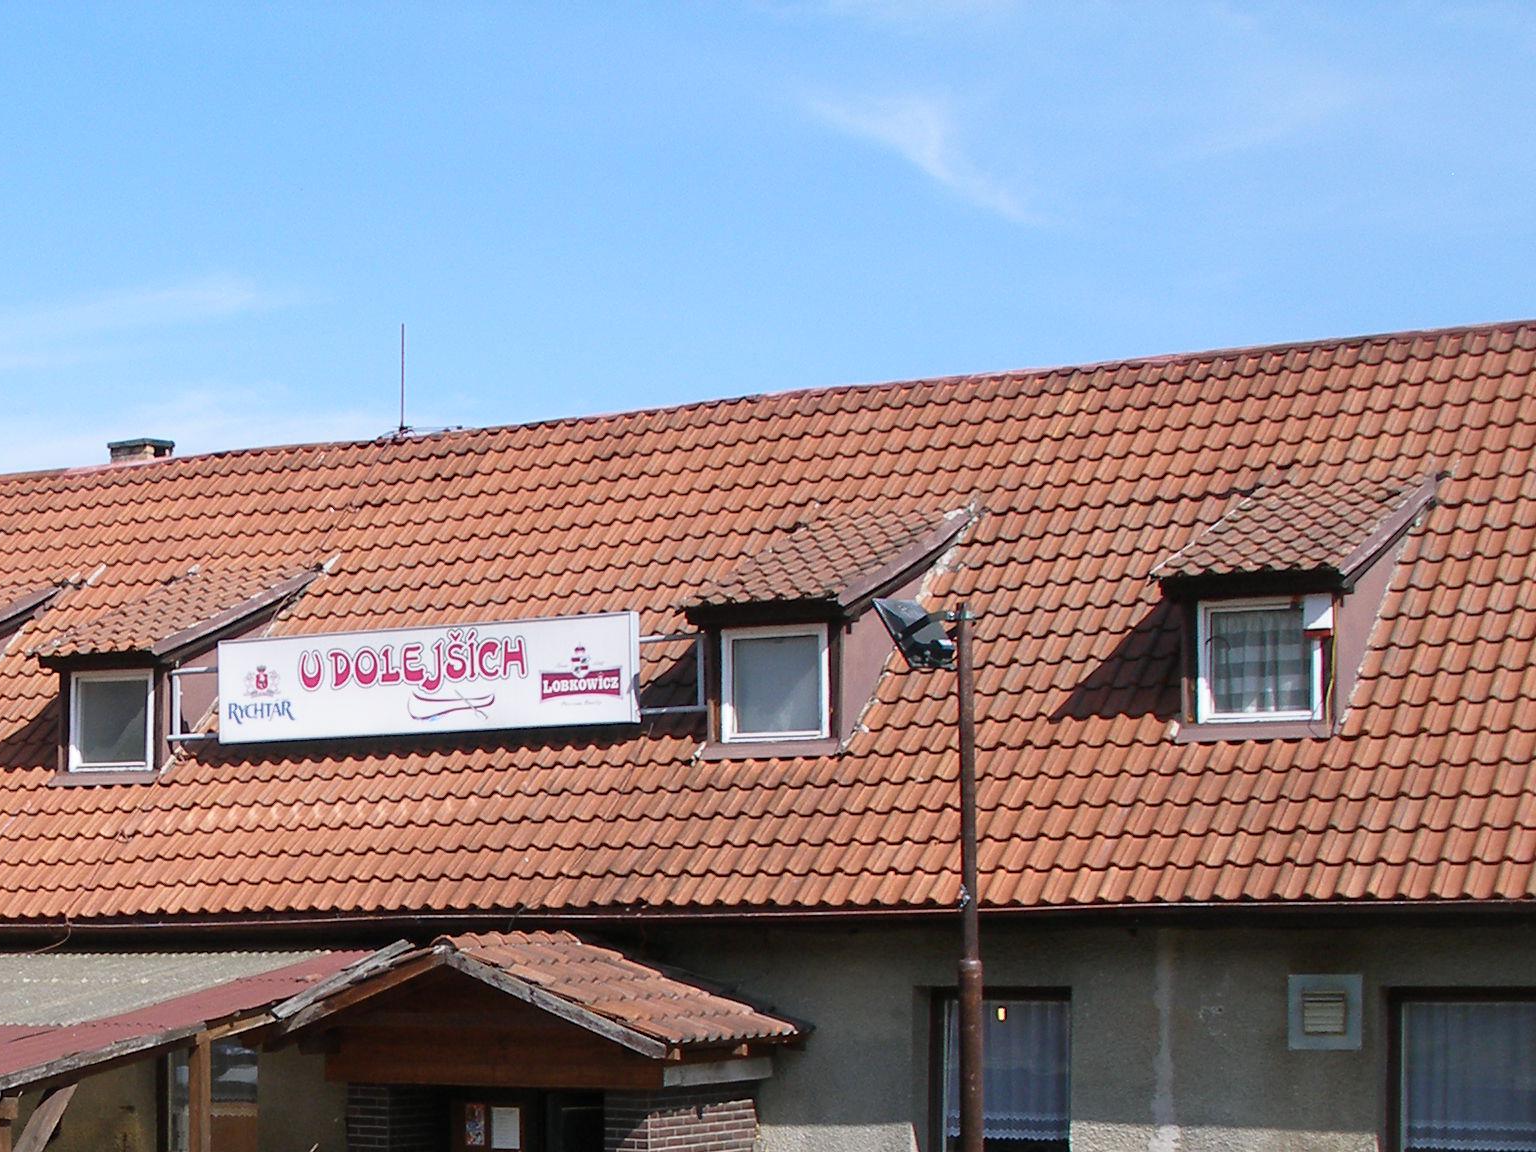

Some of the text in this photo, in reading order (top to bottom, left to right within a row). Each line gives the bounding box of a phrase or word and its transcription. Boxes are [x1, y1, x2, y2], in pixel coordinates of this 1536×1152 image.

[300, 631, 526, 691] U DOLEJŠÍCH
[542, 675, 619, 694] LOBKOWICZ
